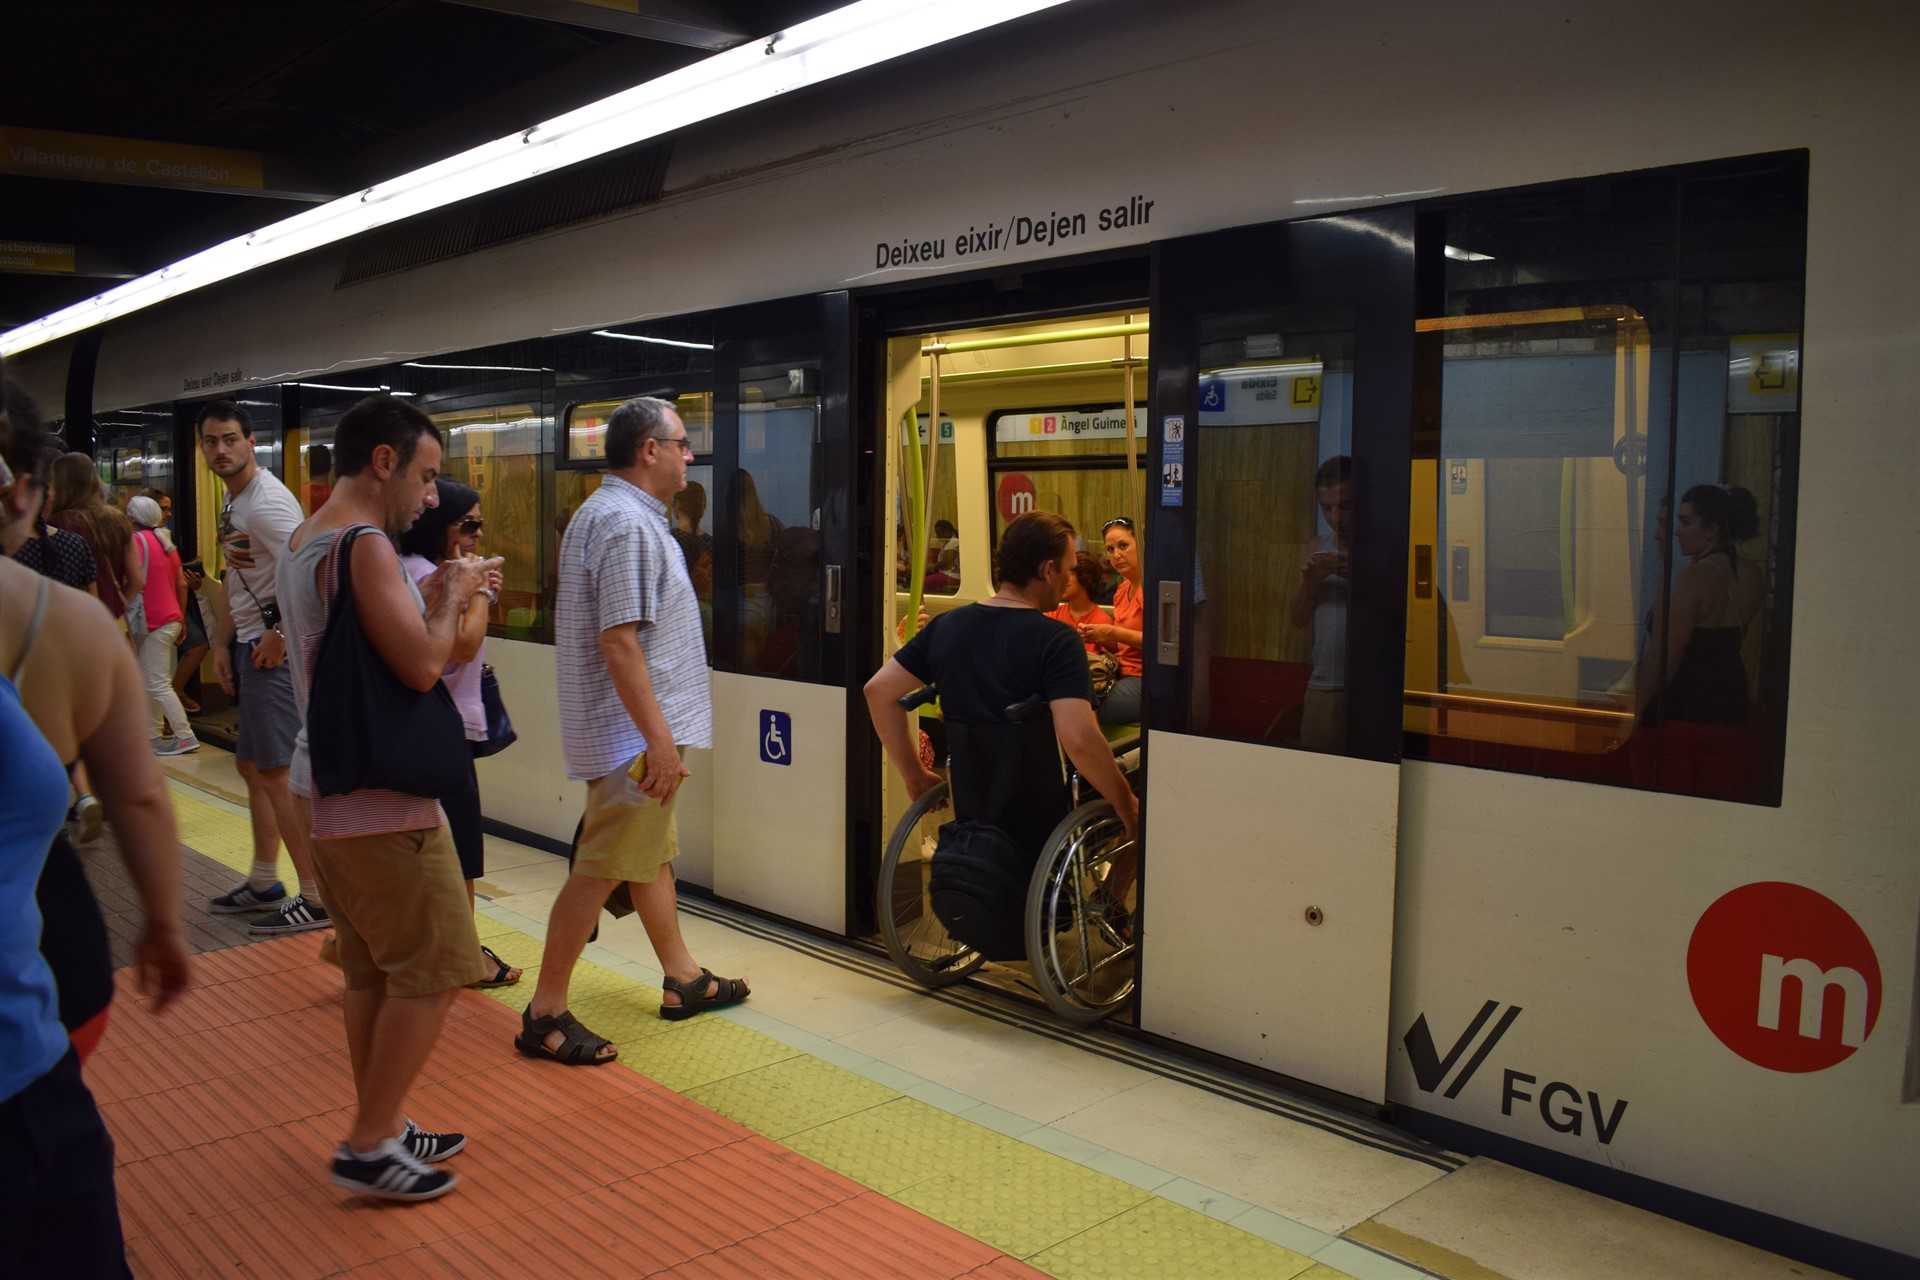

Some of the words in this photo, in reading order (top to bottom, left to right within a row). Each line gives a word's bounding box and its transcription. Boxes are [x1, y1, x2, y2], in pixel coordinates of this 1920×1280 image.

[114, 155, 138, 174] de
[875, 238, 946, 269] Deixeu
[1098, 195, 1155, 232] salir
[1061, 415, 1090, 434] Àngel
[1011, 490, 1033, 514] m
[1756, 950, 1869, 1049] m
[1501, 1068, 1629, 1145] FGV
